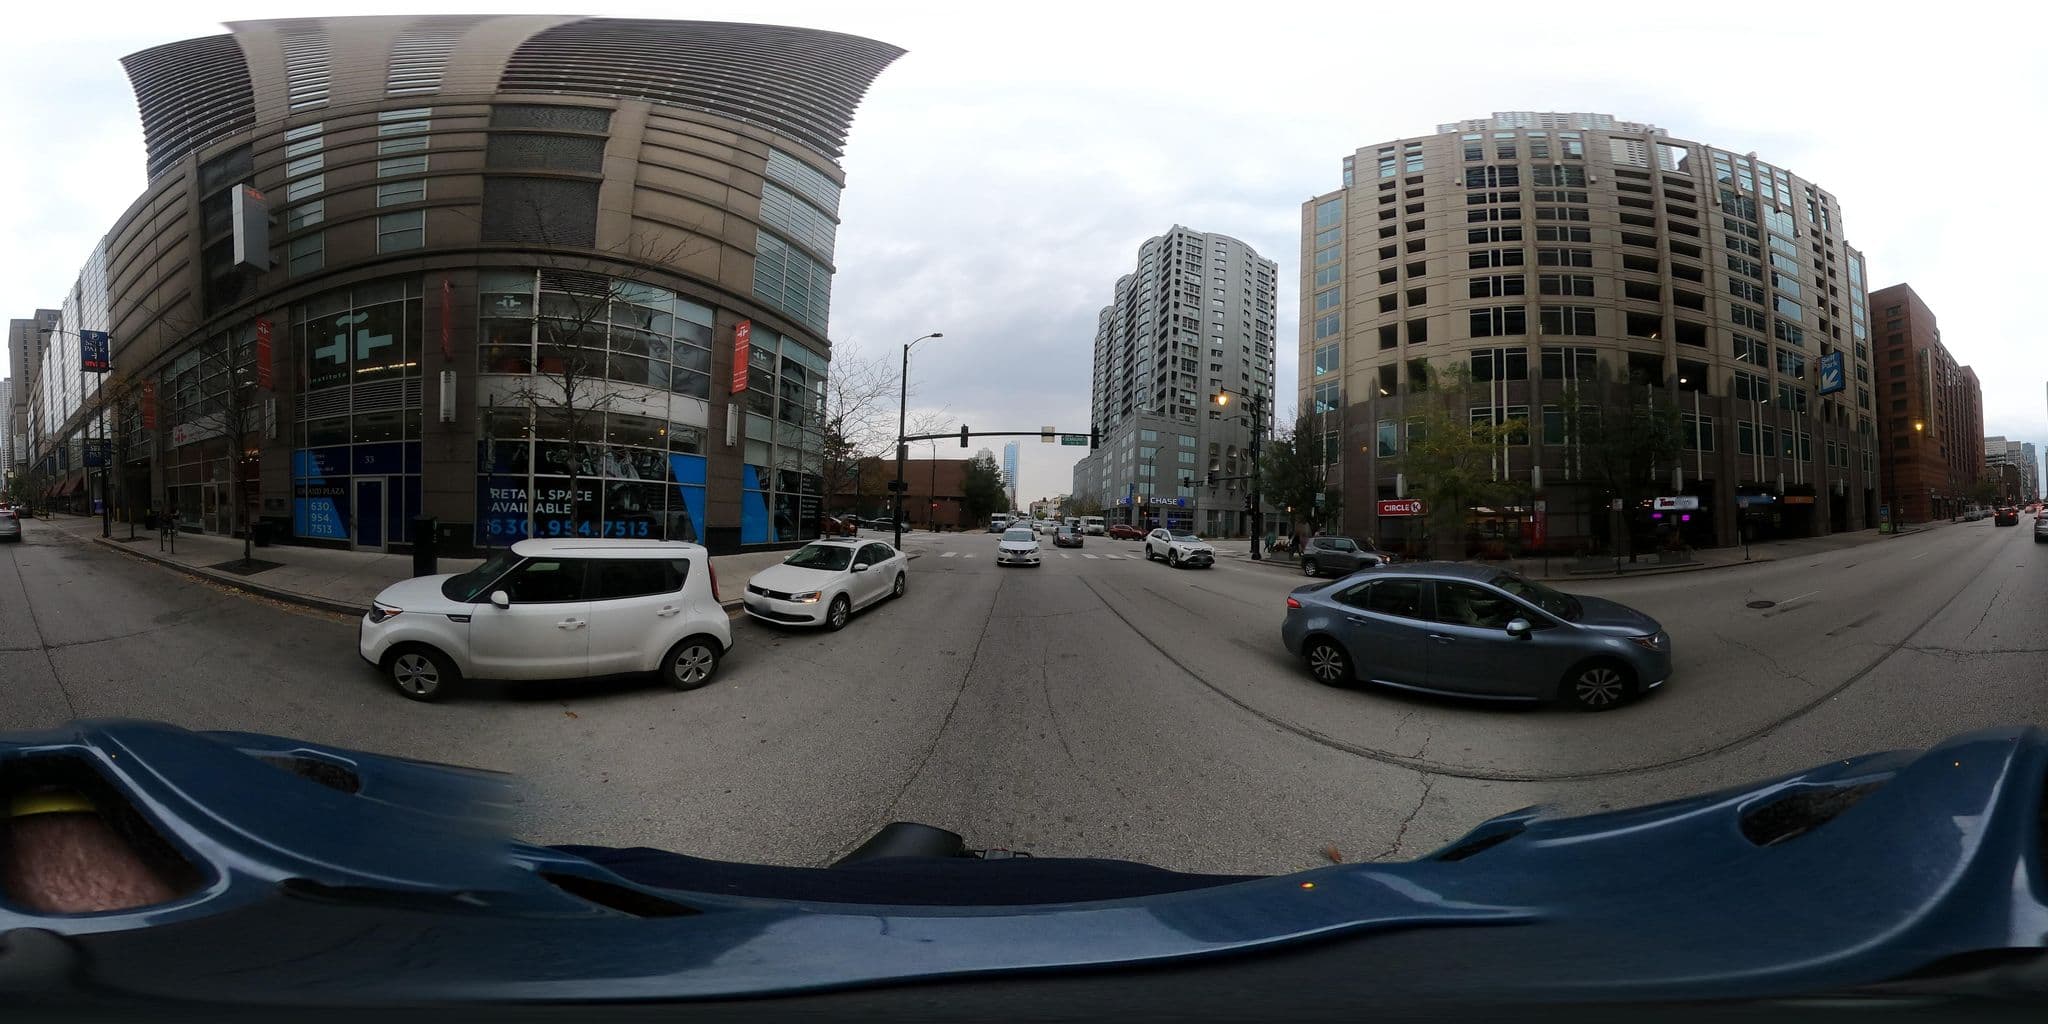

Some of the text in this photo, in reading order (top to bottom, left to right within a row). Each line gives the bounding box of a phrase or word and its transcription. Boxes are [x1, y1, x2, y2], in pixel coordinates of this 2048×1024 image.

[323, 488, 345, 496] PLAZA
[490, 488, 544, 500] RETAIL
[547, 489, 592, 502] SPACE
[1150, 497, 1177, 506] CHASE
[491, 502, 572, 514] AVAILABLE
[1384, 504, 1410, 512] CIRCLE
[311, 524, 333, 535] 7513
[489, 518, 649, 537] 630.954.7513
